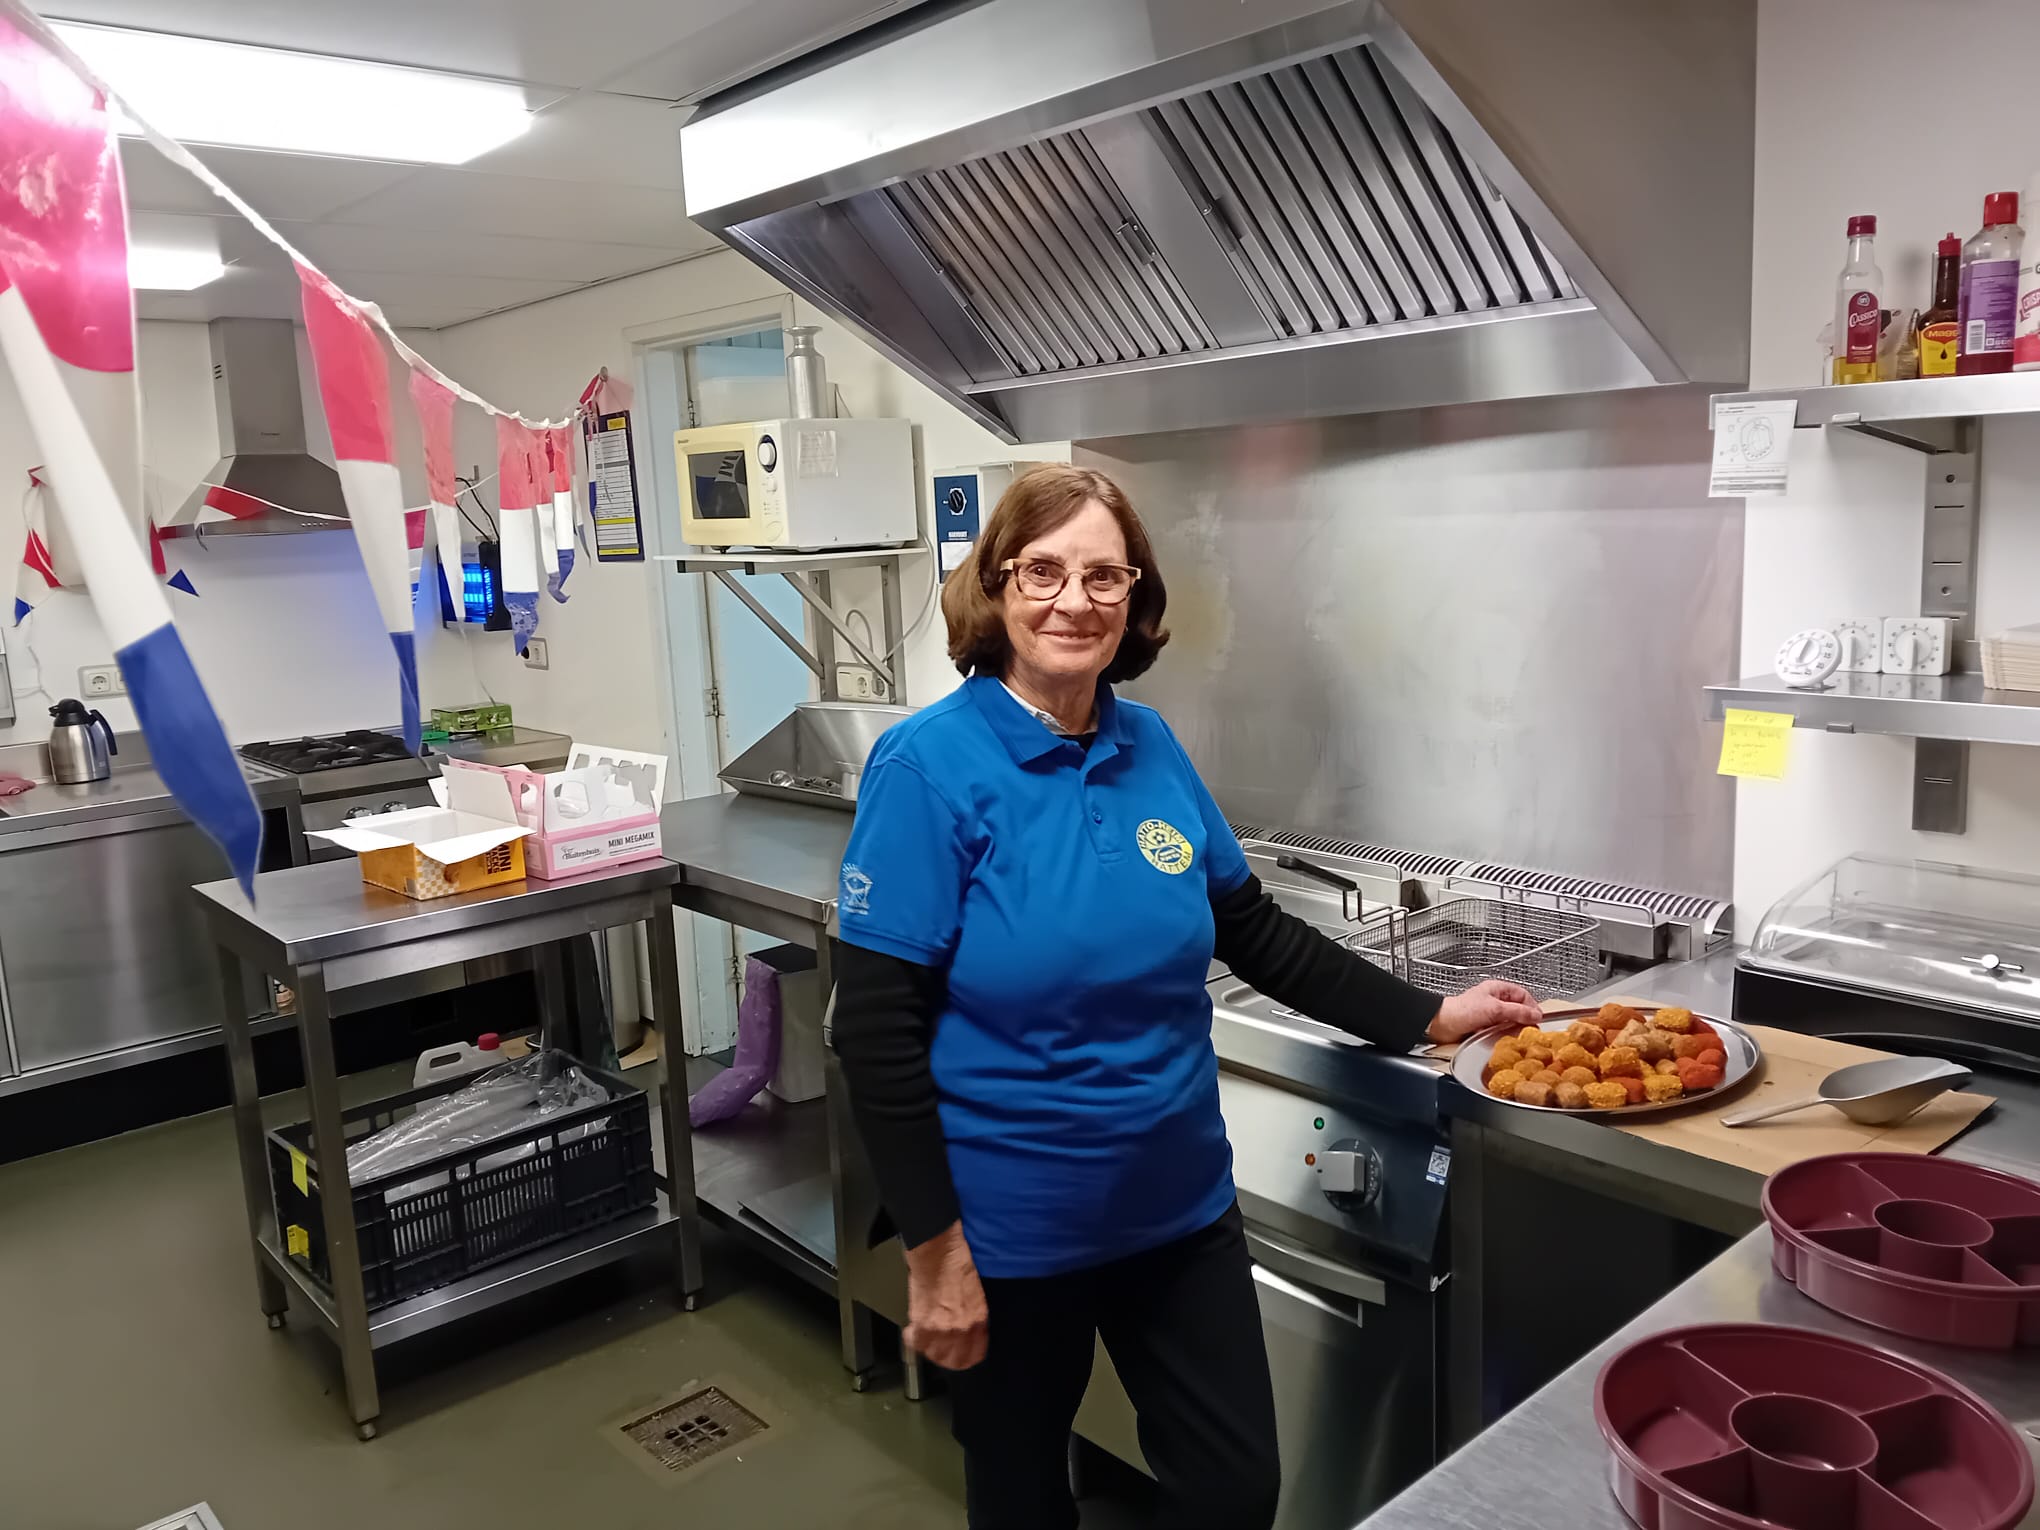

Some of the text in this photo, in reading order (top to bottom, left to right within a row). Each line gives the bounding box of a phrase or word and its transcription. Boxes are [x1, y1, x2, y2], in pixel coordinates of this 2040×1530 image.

[1928, 329, 1959, 338] MAGG
[608, 838, 624, 848] MINI
[625, 831, 655, 844] MEGAMIX
